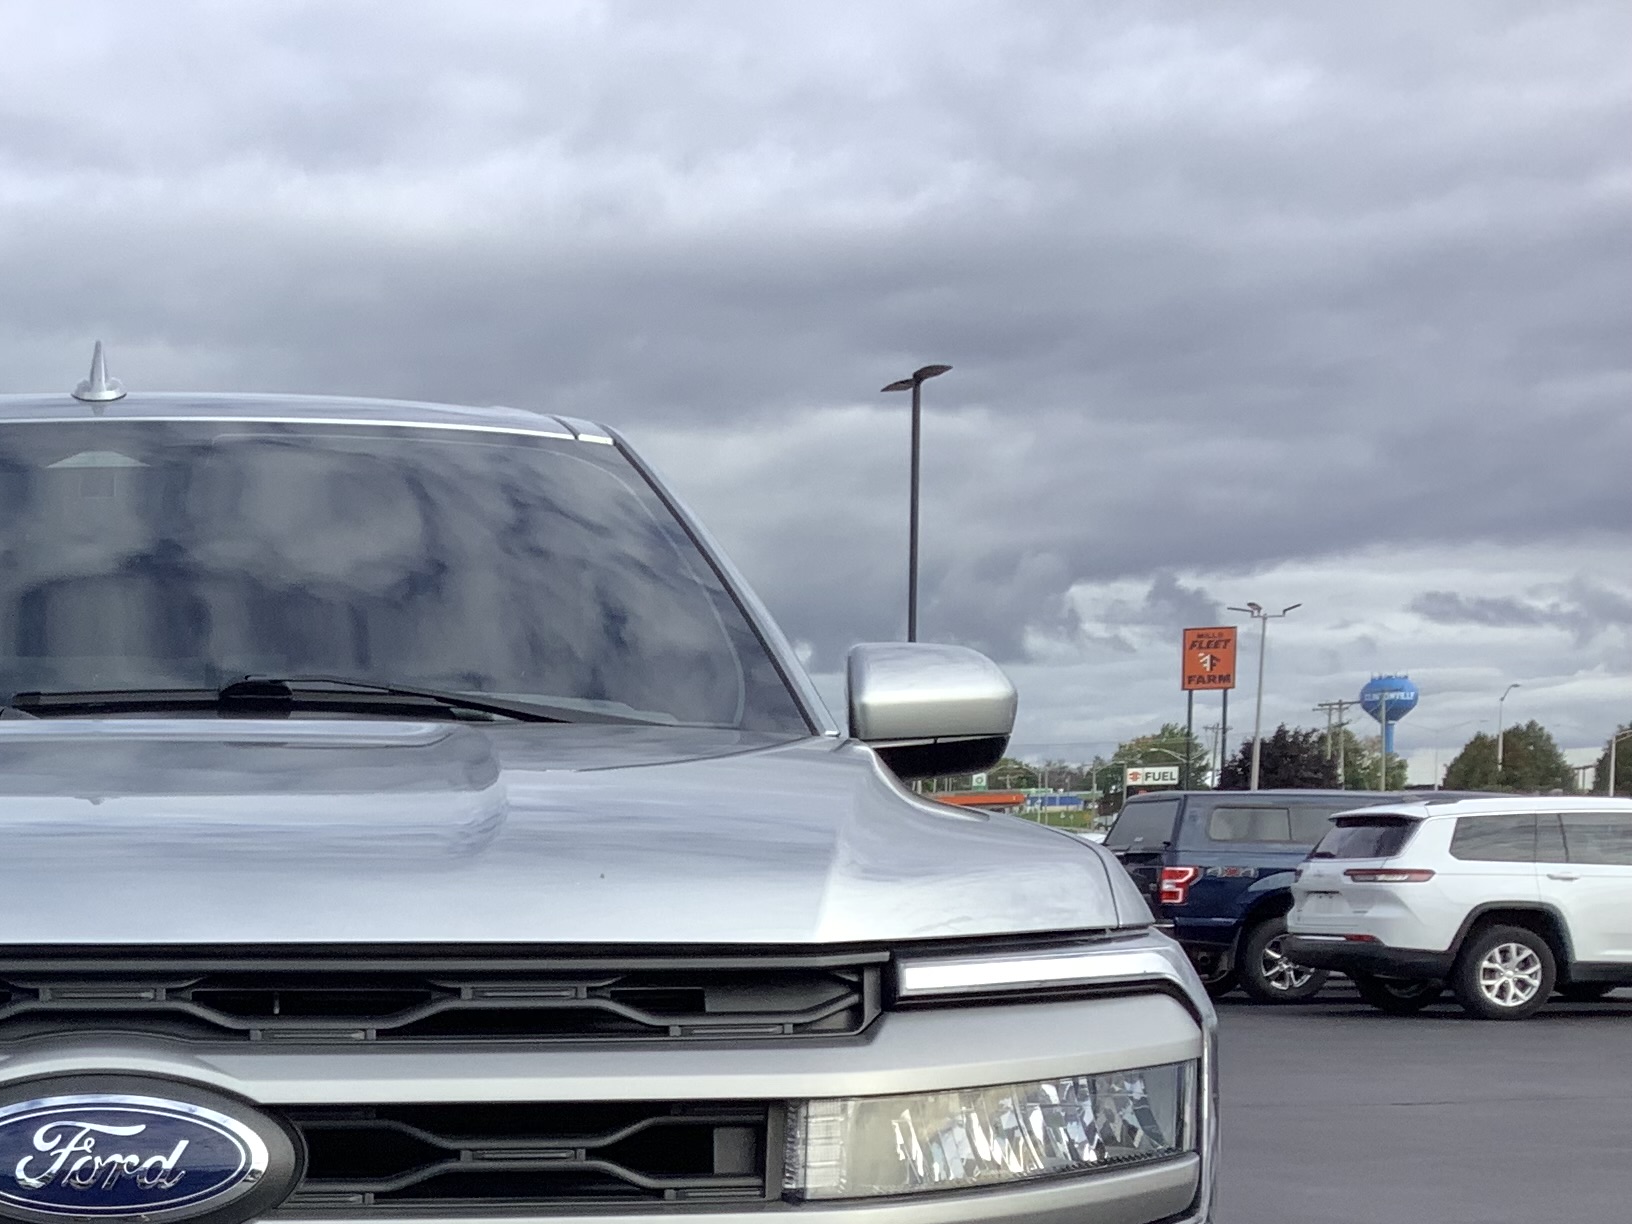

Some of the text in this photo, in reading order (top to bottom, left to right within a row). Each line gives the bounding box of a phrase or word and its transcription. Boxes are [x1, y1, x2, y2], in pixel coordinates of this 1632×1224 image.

[1188, 638, 1231, 650] FLEET
[1187, 674, 1231, 684] FARM
[1144, 771, 1177, 782] FUEL
[15, 1121, 190, 1190] Ford
